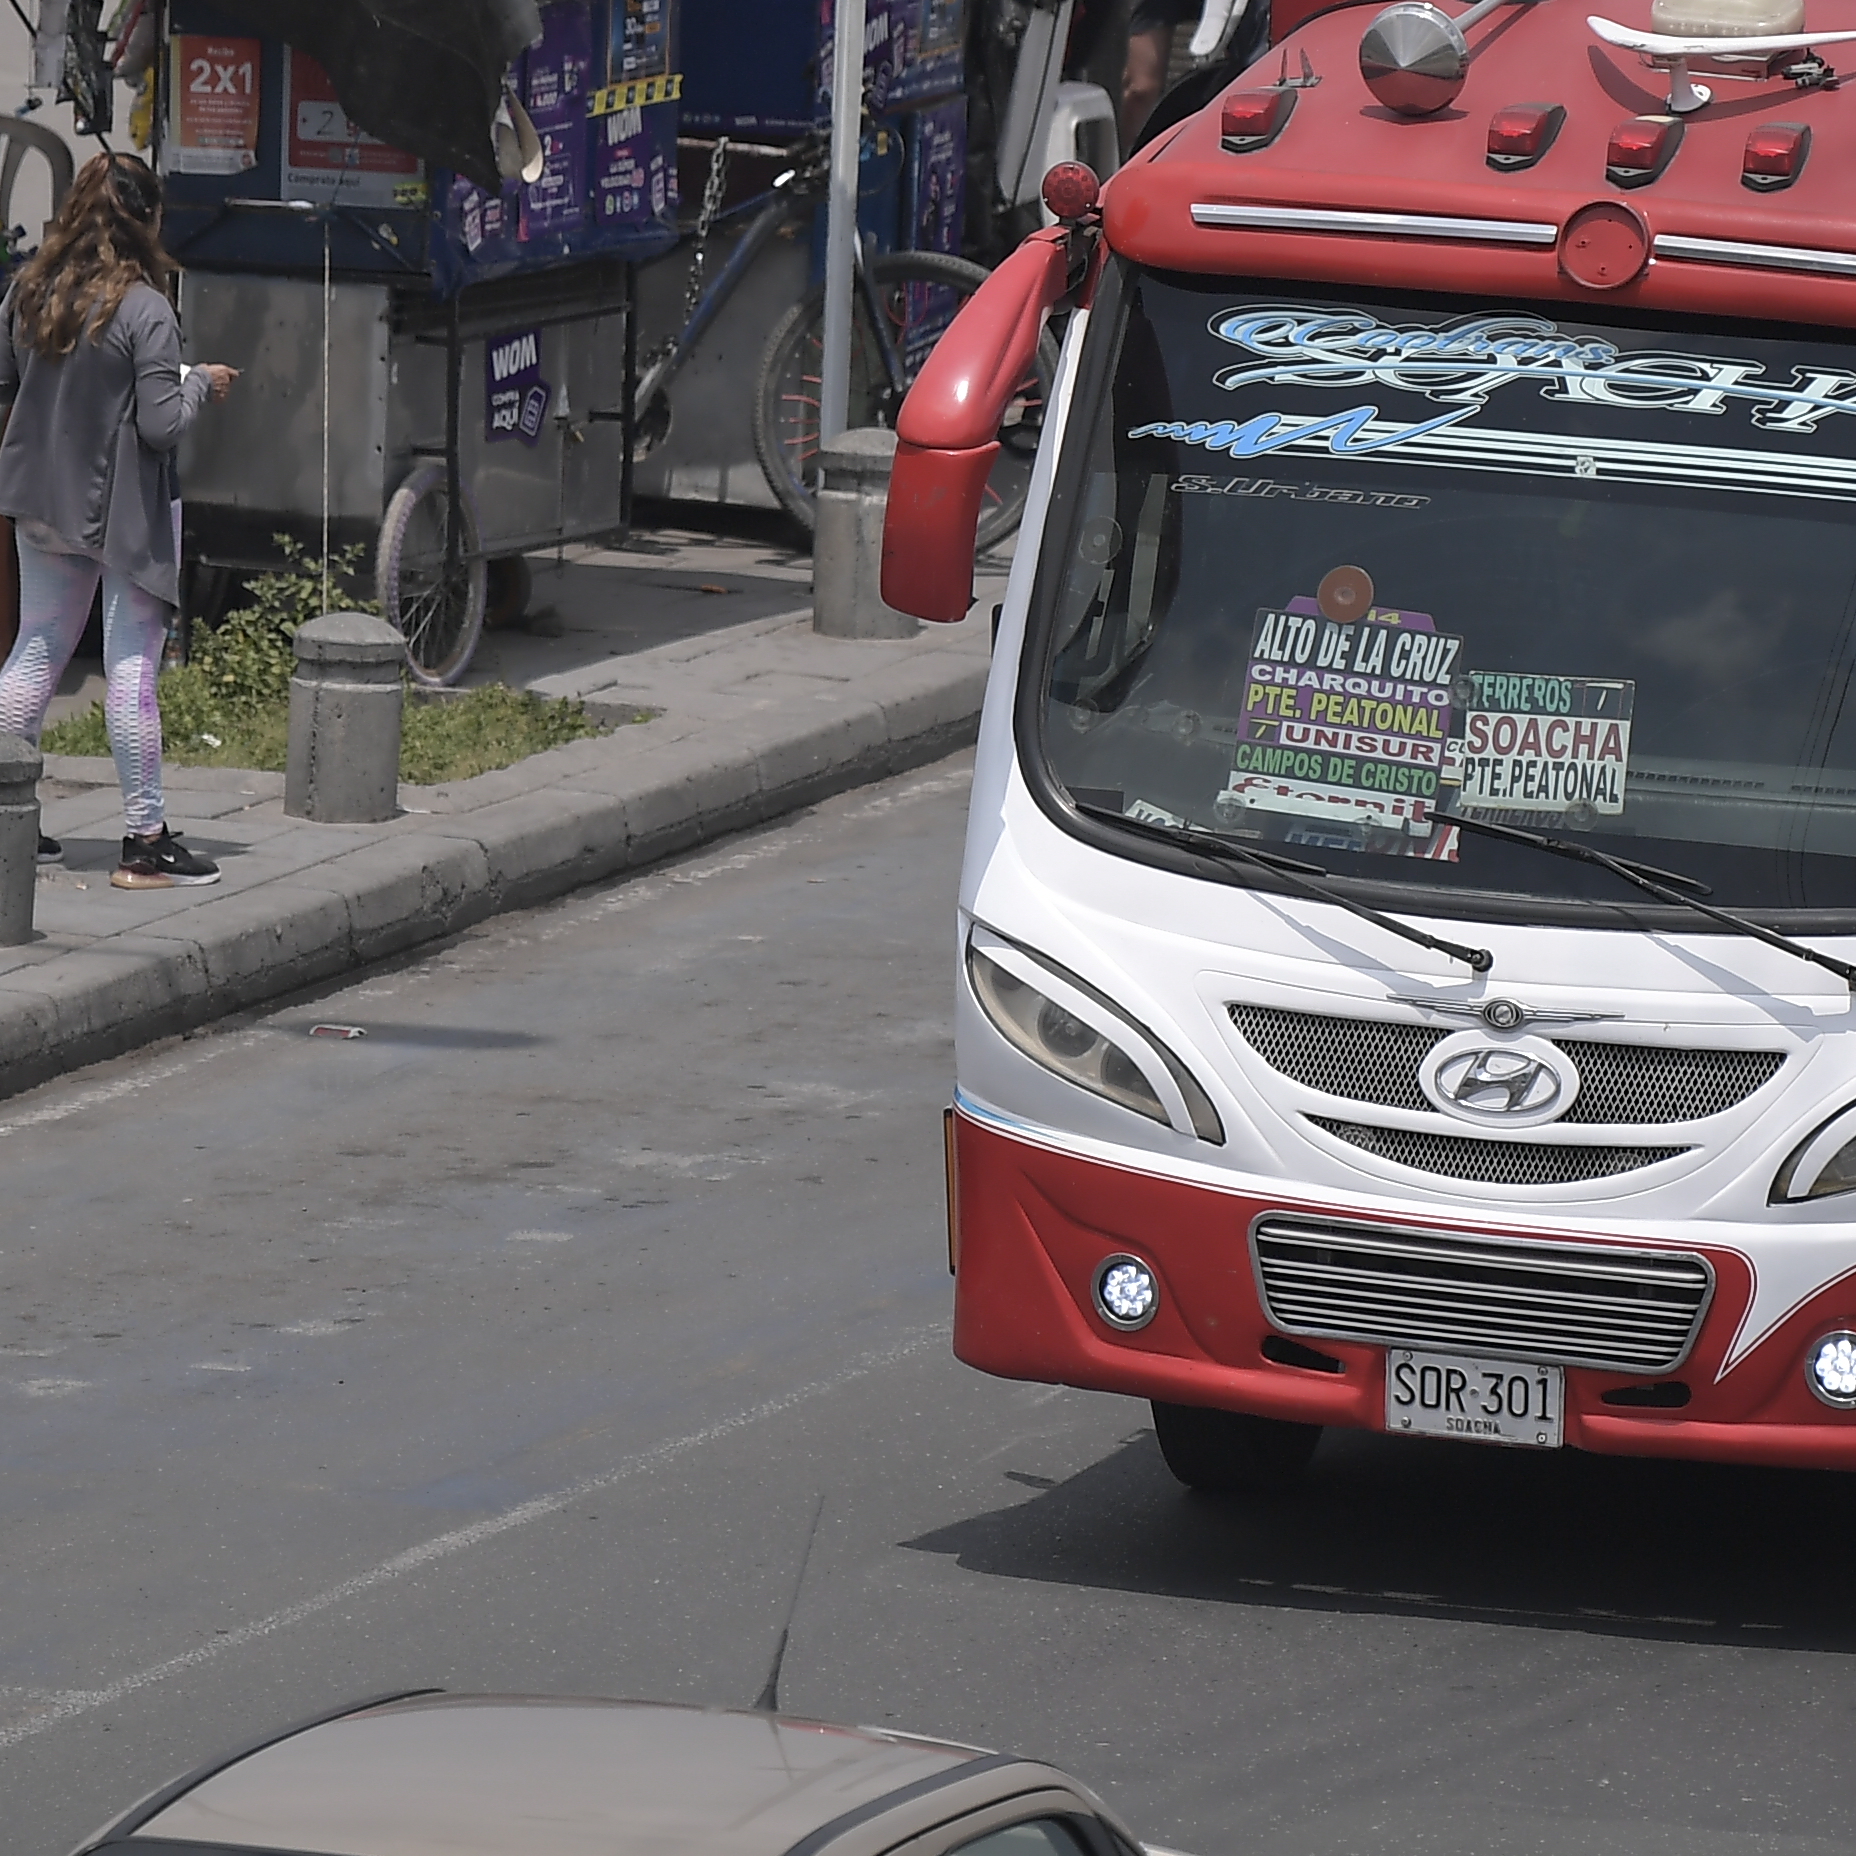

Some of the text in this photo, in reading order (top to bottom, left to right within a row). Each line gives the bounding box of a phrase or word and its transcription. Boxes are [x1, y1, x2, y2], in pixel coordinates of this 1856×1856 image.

[189, 58, 253, 95] 2x1
[607, 106, 642, 146] WOM
[492, 333, 538, 381] WOM
[1212, 307, 1615, 364] Cootrans
[1253, 613, 1460, 685] ALTO DE LA CRUZ
[1250, 663, 1451, 707] CHARQUITO
[1470, 674, 1574, 715] TERREROS
[1246, 682, 1445, 739] PTE. PEATONAL
[1284, 724, 1437, 764] UNISUR
[1466, 713, 1624, 764] SOACHA
[1236, 744, 1438, 796] CAMPOS DE CRISTO
[1446, 1417, 1502, 1435] SOACHA
